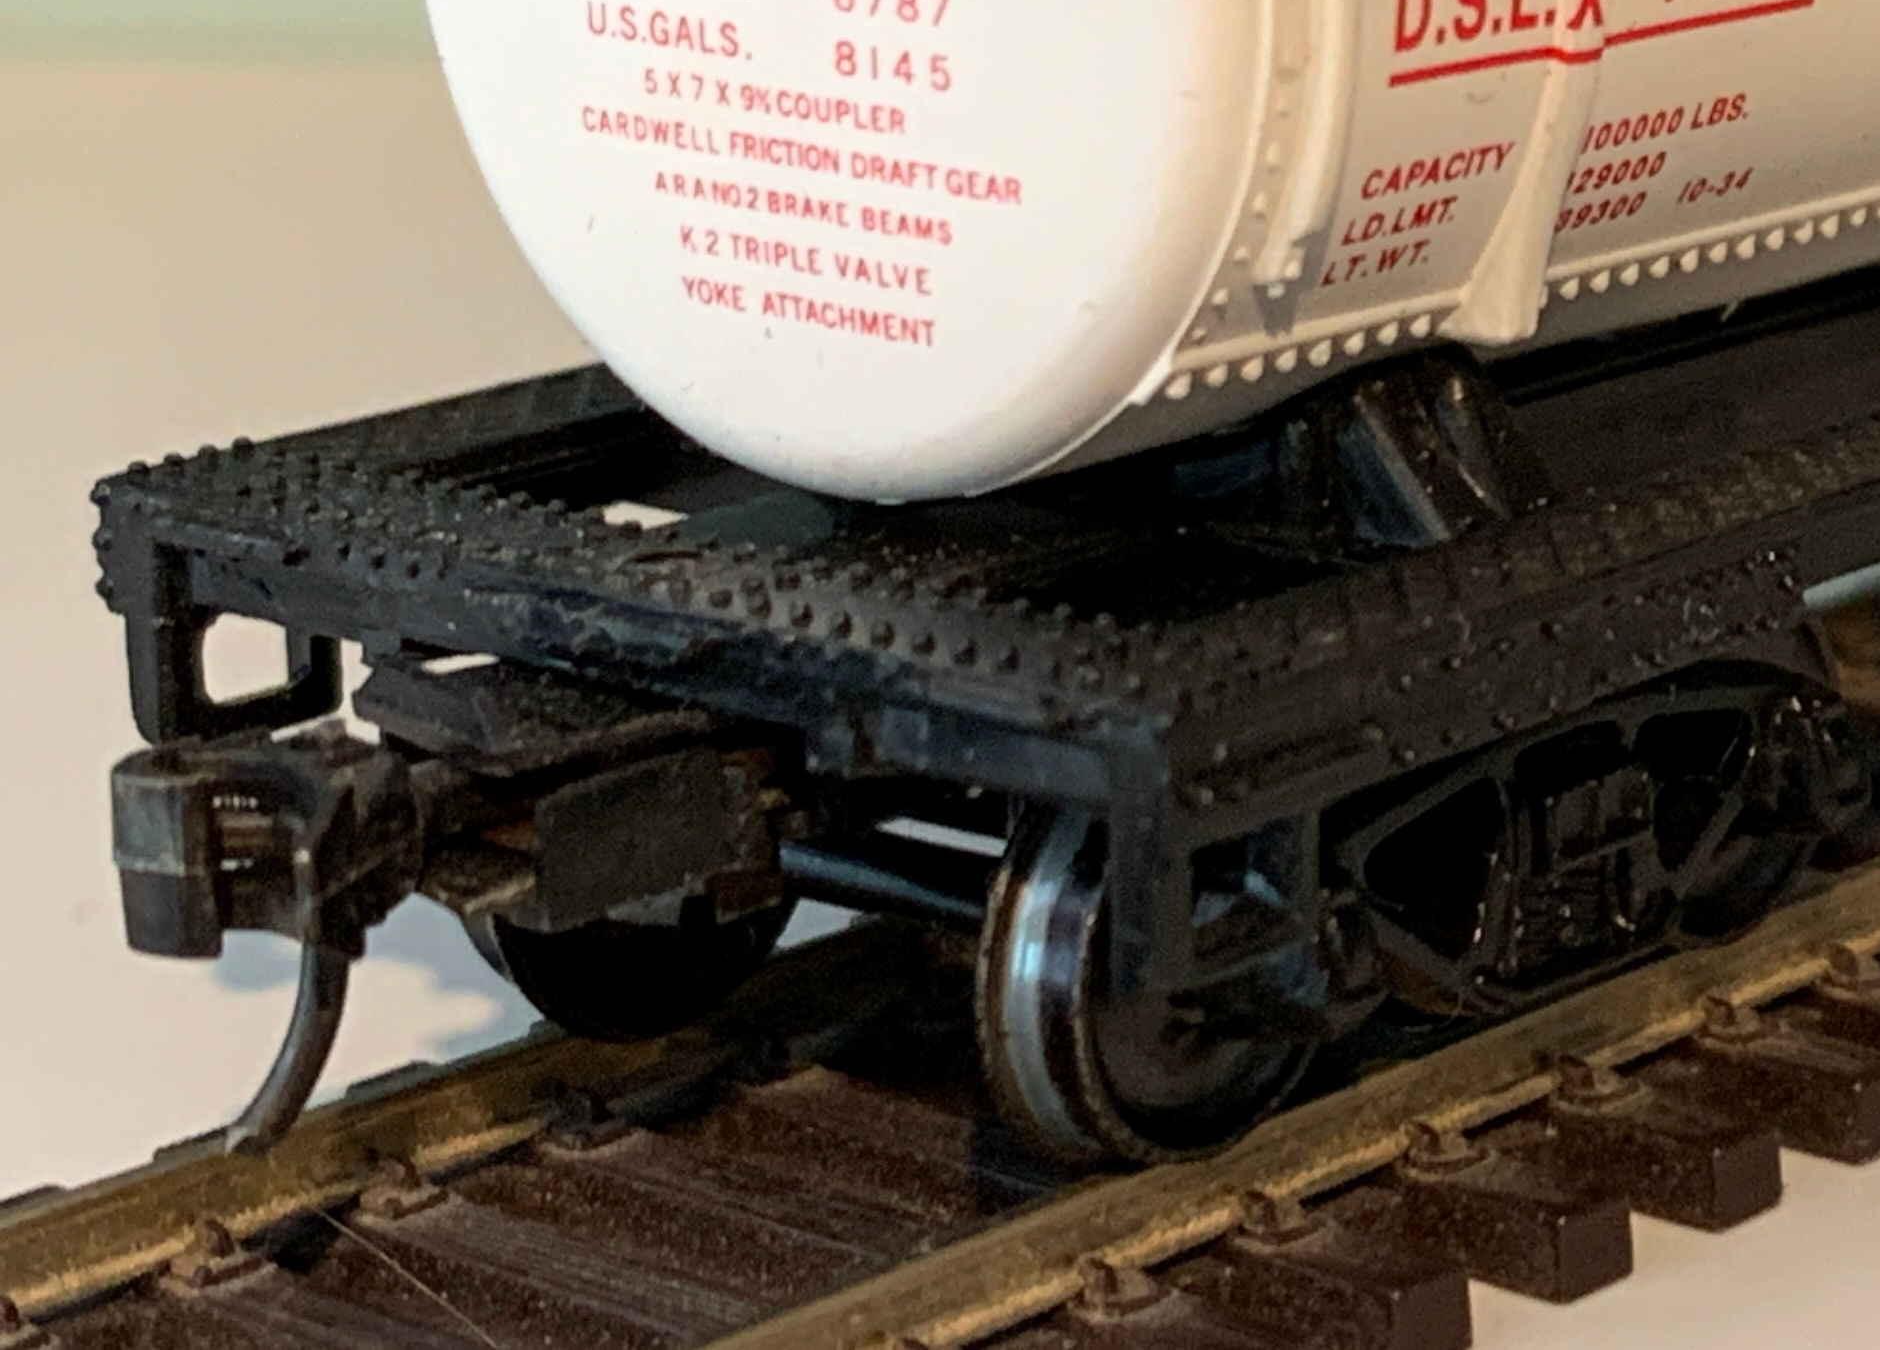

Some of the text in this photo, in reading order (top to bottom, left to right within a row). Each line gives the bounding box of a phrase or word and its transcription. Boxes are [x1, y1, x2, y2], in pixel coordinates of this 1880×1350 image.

[835, 40, 951, 92] 8145
[776, 90, 904, 133] COUPLER
[583, 106, 1021, 204] CARDWELL FRICTION DRAFT GEAR
[1361, 140, 1516, 200] CAPACITY
[1690, 93, 1748, 130] LBS.
[766, 190, 849, 227] BRAKE
[860, 206, 952, 245] BEAMS
[730, 234, 821, 275] TRIPLE
[834, 254, 931, 295] VALVE
[682, 277, 934, 346] YOKE ATTACHMENT
